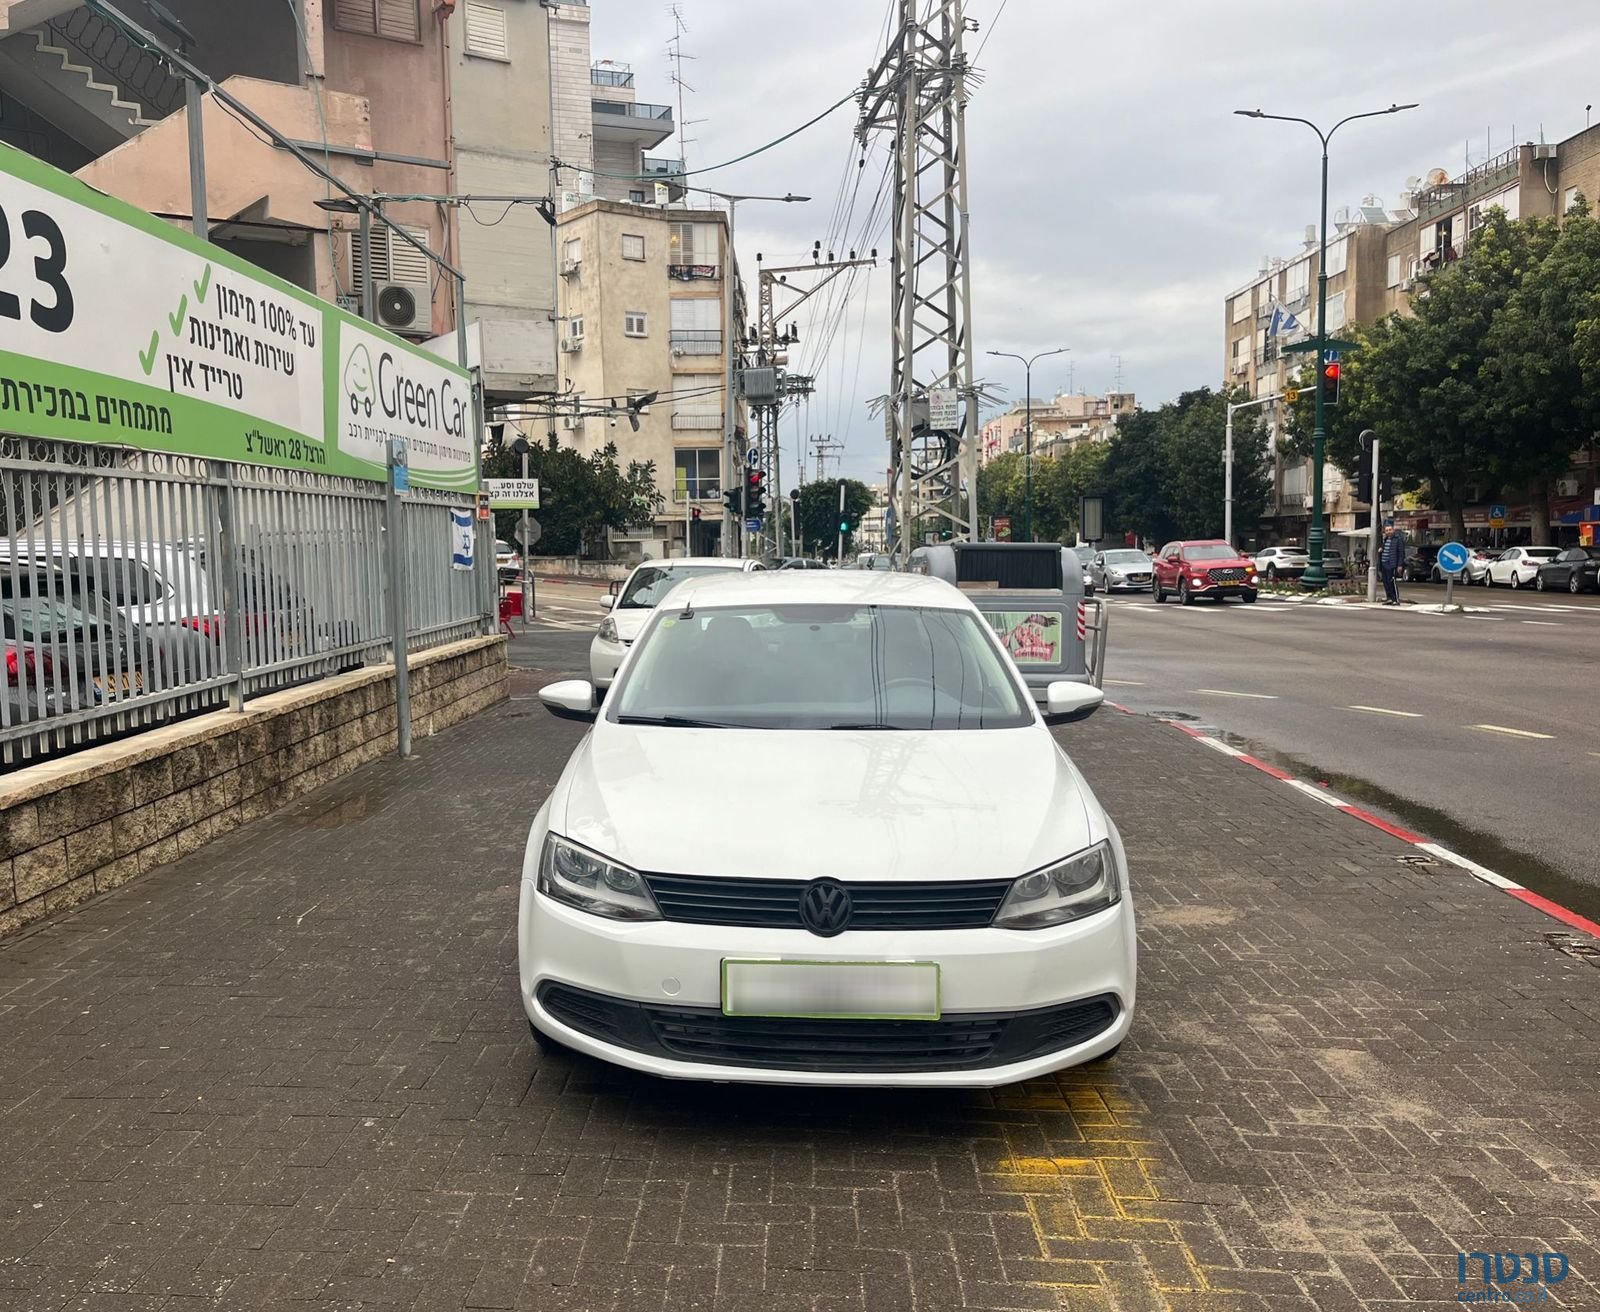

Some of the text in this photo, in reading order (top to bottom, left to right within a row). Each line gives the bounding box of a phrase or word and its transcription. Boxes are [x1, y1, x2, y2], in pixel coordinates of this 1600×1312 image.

[216, 283, 315, 348] עד 100% מימון
[189, 315, 295, 376] שירות ואמינות
[166, 353, 243, 400] טרייד אין
[378, 352, 467, 439] Green Car
[1286, 391, 1296, 400] 13
[0, 377, 173, 435] מתמחים במכירת
[245, 429, 326, 465] הרצל 28 ראשל"צ
[348, 422, 363, 439] רכב
[512, 490, 534, 498] אצלנו
[516, 481, 534, 489] שלם
